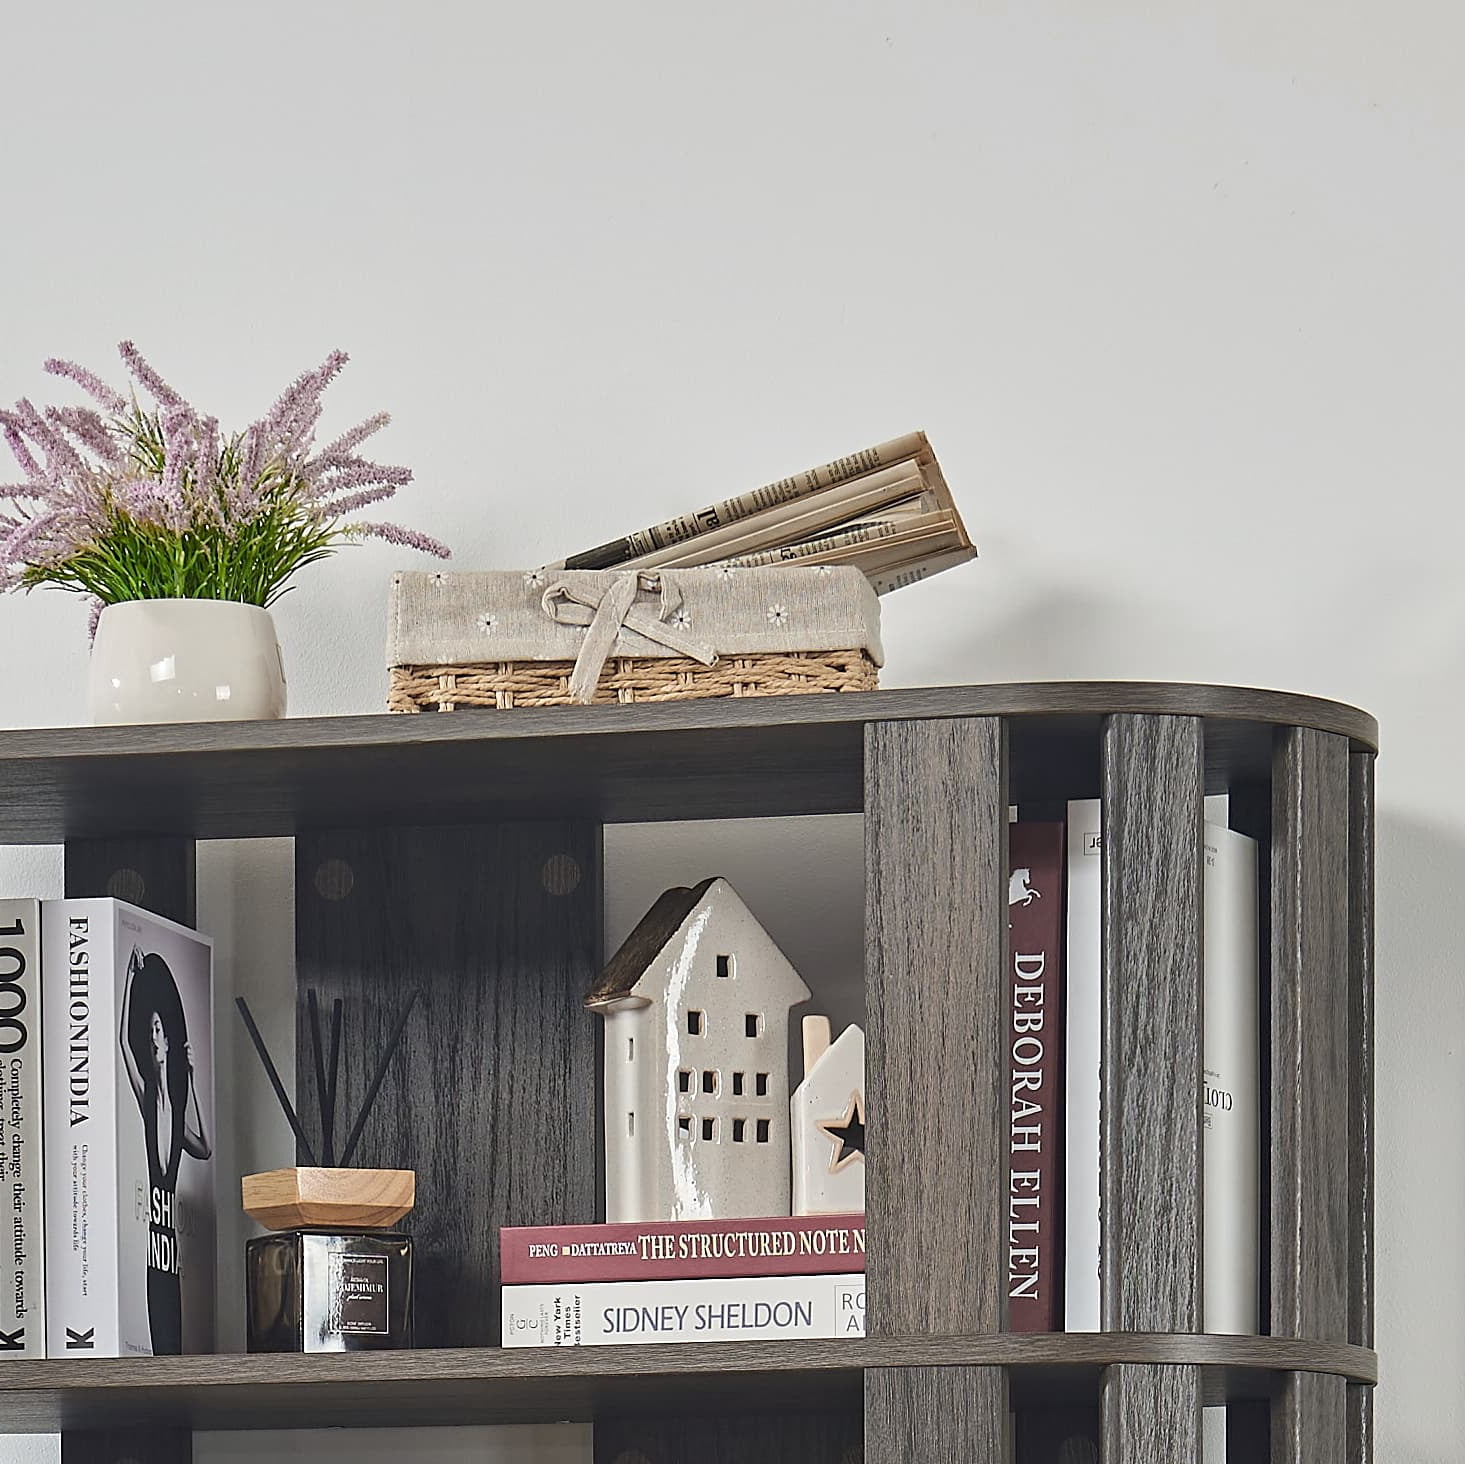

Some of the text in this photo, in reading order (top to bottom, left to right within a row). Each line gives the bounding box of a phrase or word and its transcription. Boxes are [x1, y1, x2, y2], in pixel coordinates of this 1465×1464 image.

[69, 916, 89, 1128] FASHIONINDIA
[1008, 951, 1045, 1301] DEBORAH ELLEN
[8, 1058, 27, 1319] Completely change their attitude towards
[528, 1244, 558, 1258] PENG
[570, 1242, 637, 1258] DATTATREYA
[638, 1234, 676, 1261] THE
[680, 1231, 796, 1260] STRUCTURED
[799, 1229, 851, 1255] NOTE
[553, 1296, 561, 1322] York
[563, 1306, 571, 1339] Times
[602, 1301, 812, 1333] SIDNEY SHELDON
[65, 1327, 95, 1350] K
